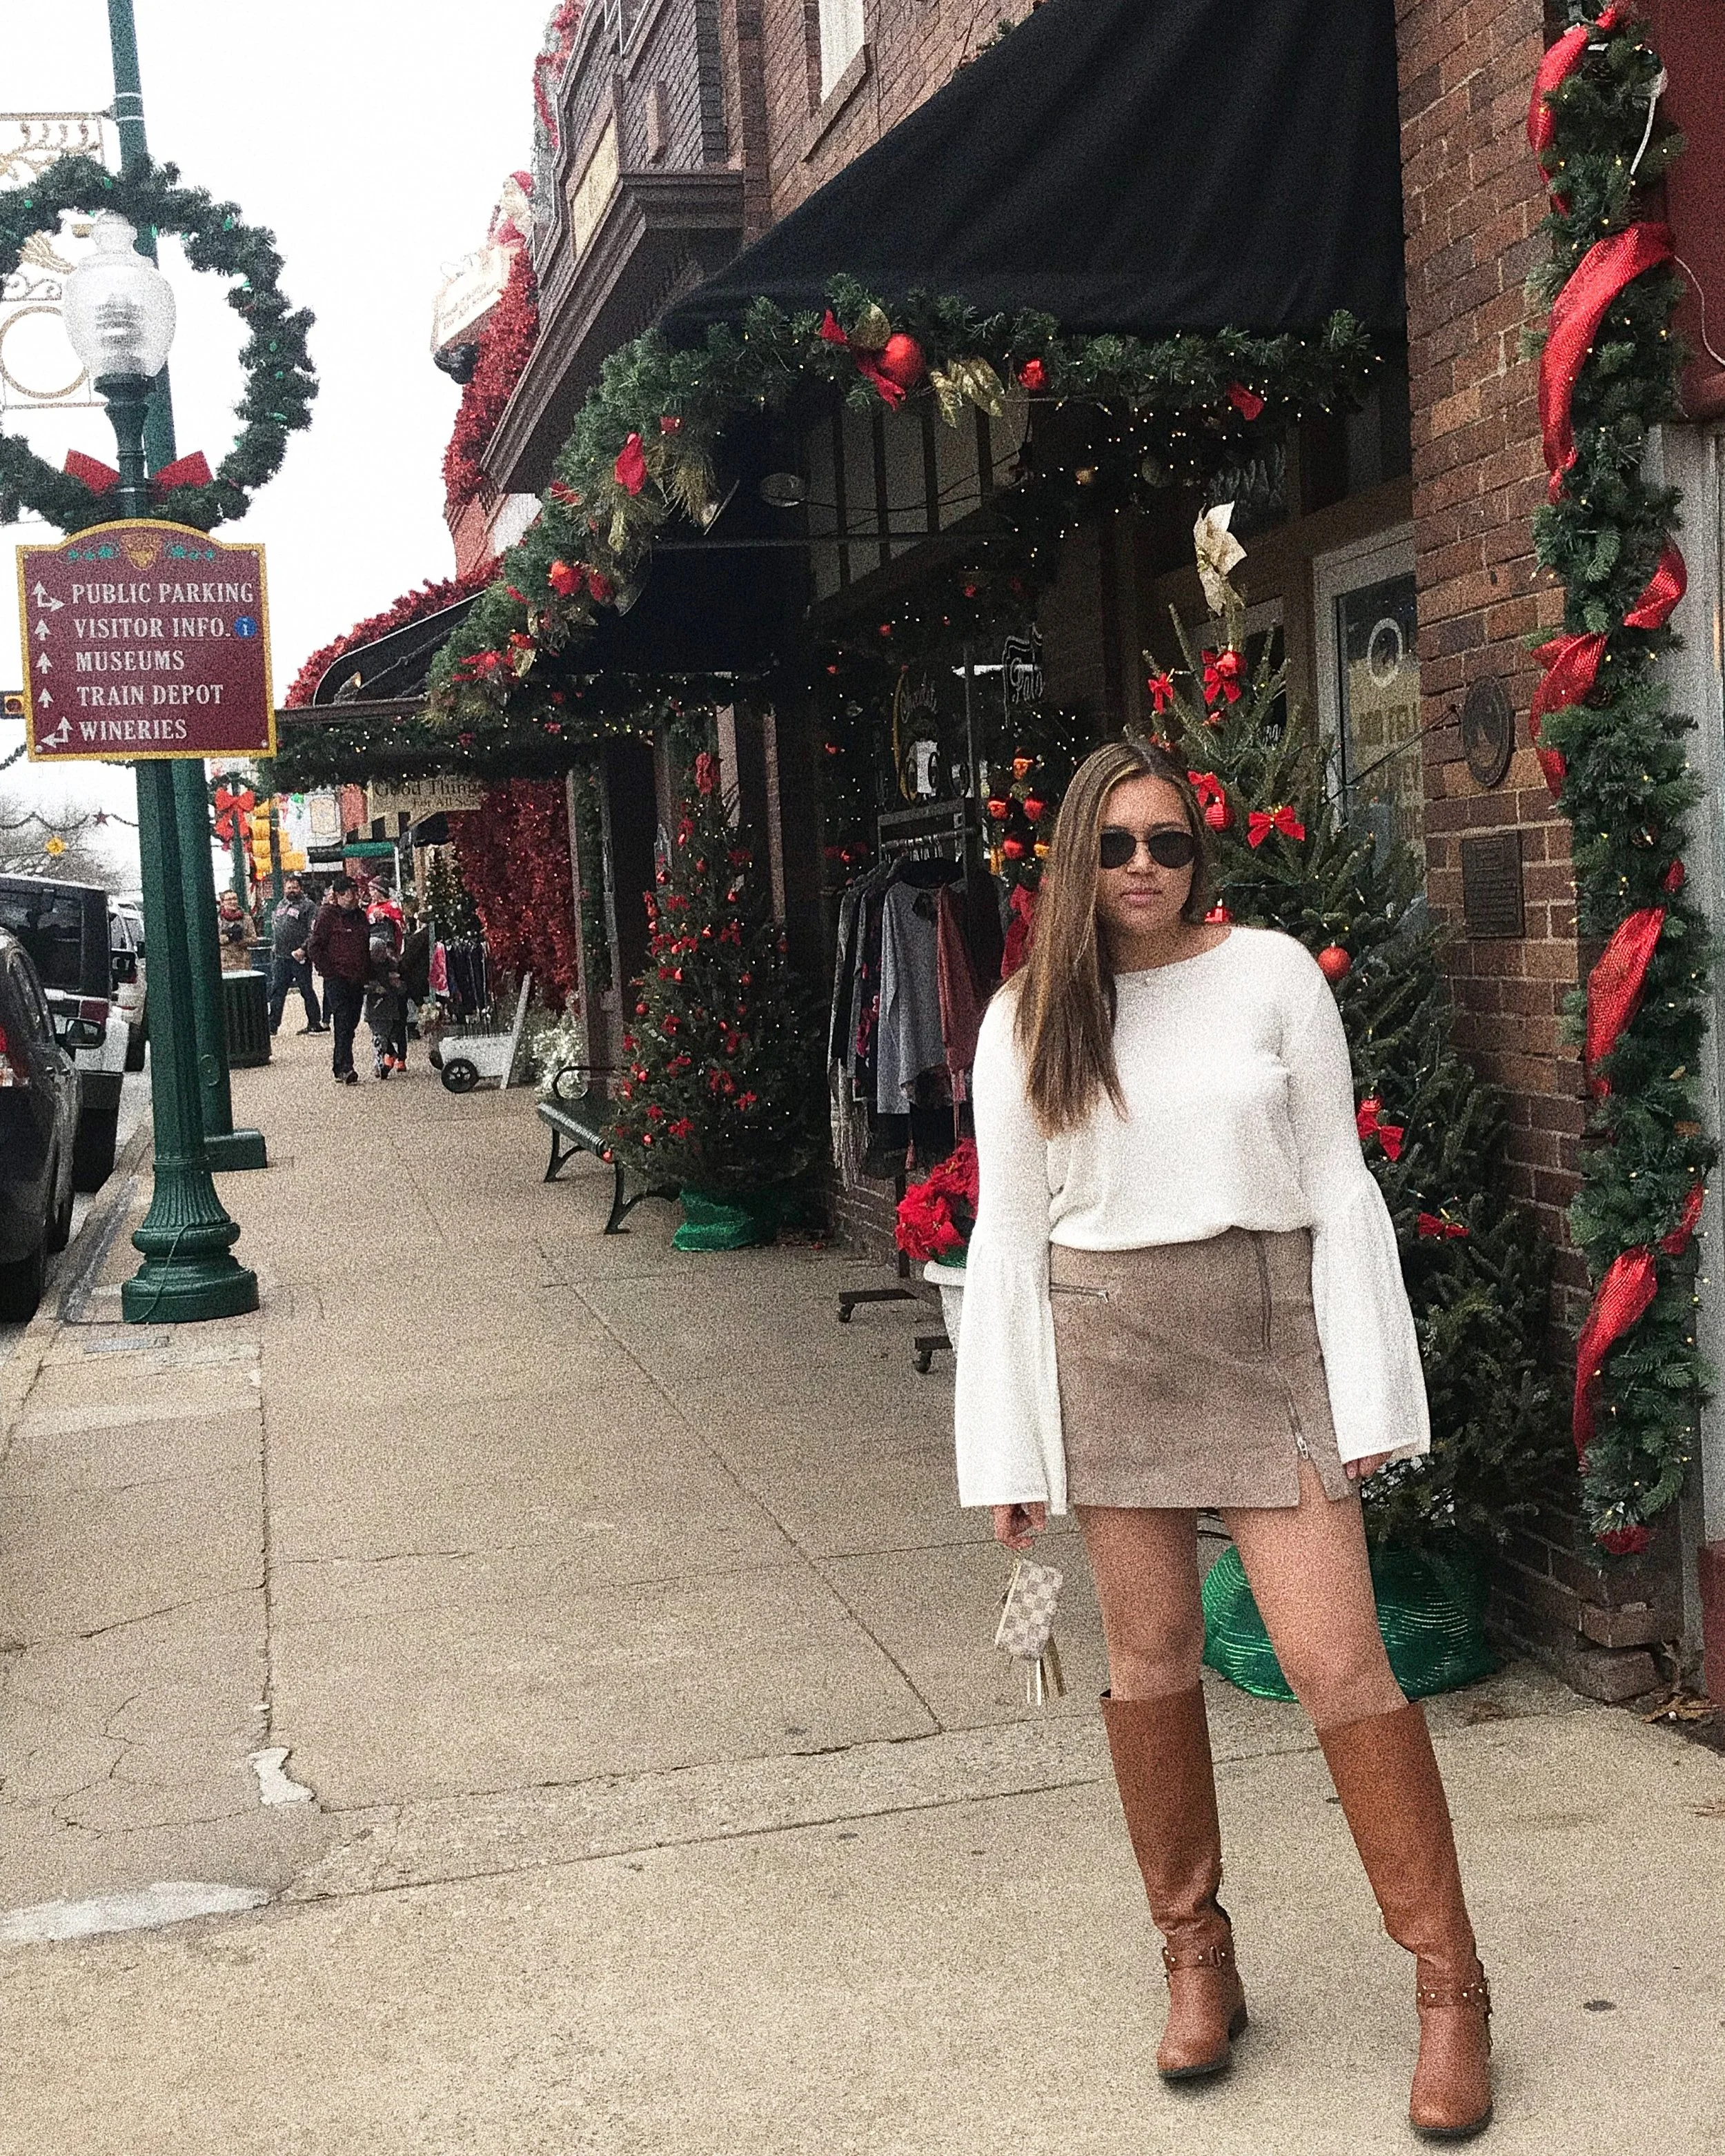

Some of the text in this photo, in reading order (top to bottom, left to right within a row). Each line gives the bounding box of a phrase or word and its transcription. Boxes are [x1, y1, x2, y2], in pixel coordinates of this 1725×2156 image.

[72, 582, 254, 604] PUBLIC PARKING
[74, 617, 164, 639] VISITOR
[173, 617, 232, 638] INFO.
[76, 650, 185, 673] MUSEUMS
[77, 684, 224, 707] TRAIN DEPOT
[79, 719, 188, 742] WINERIES
[375, 780, 422, 797] Good
